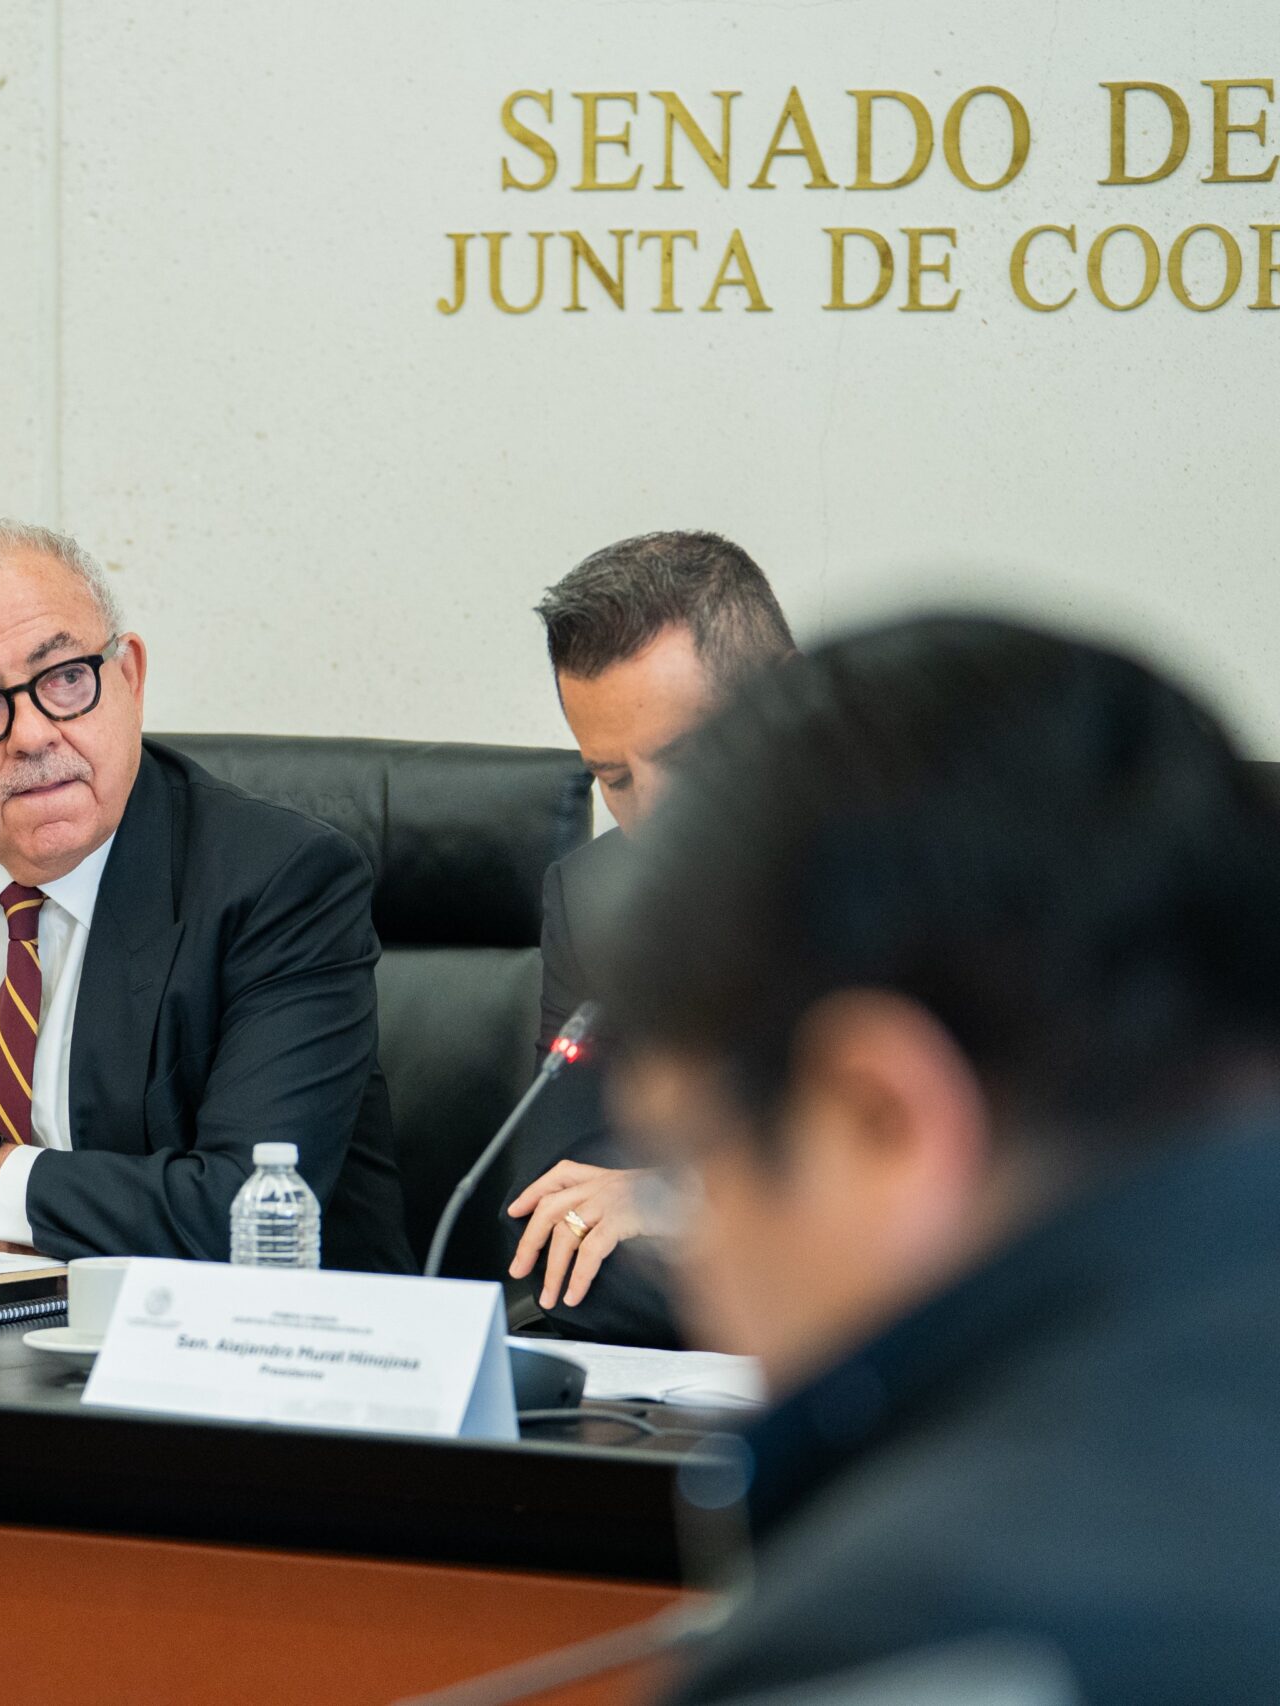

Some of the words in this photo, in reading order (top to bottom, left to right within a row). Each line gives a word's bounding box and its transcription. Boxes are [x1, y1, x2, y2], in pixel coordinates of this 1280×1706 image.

[500, 85, 1030, 192] SENADO
[437, 228, 772, 315] JUNTA
[821, 226, 961, 312] DE
